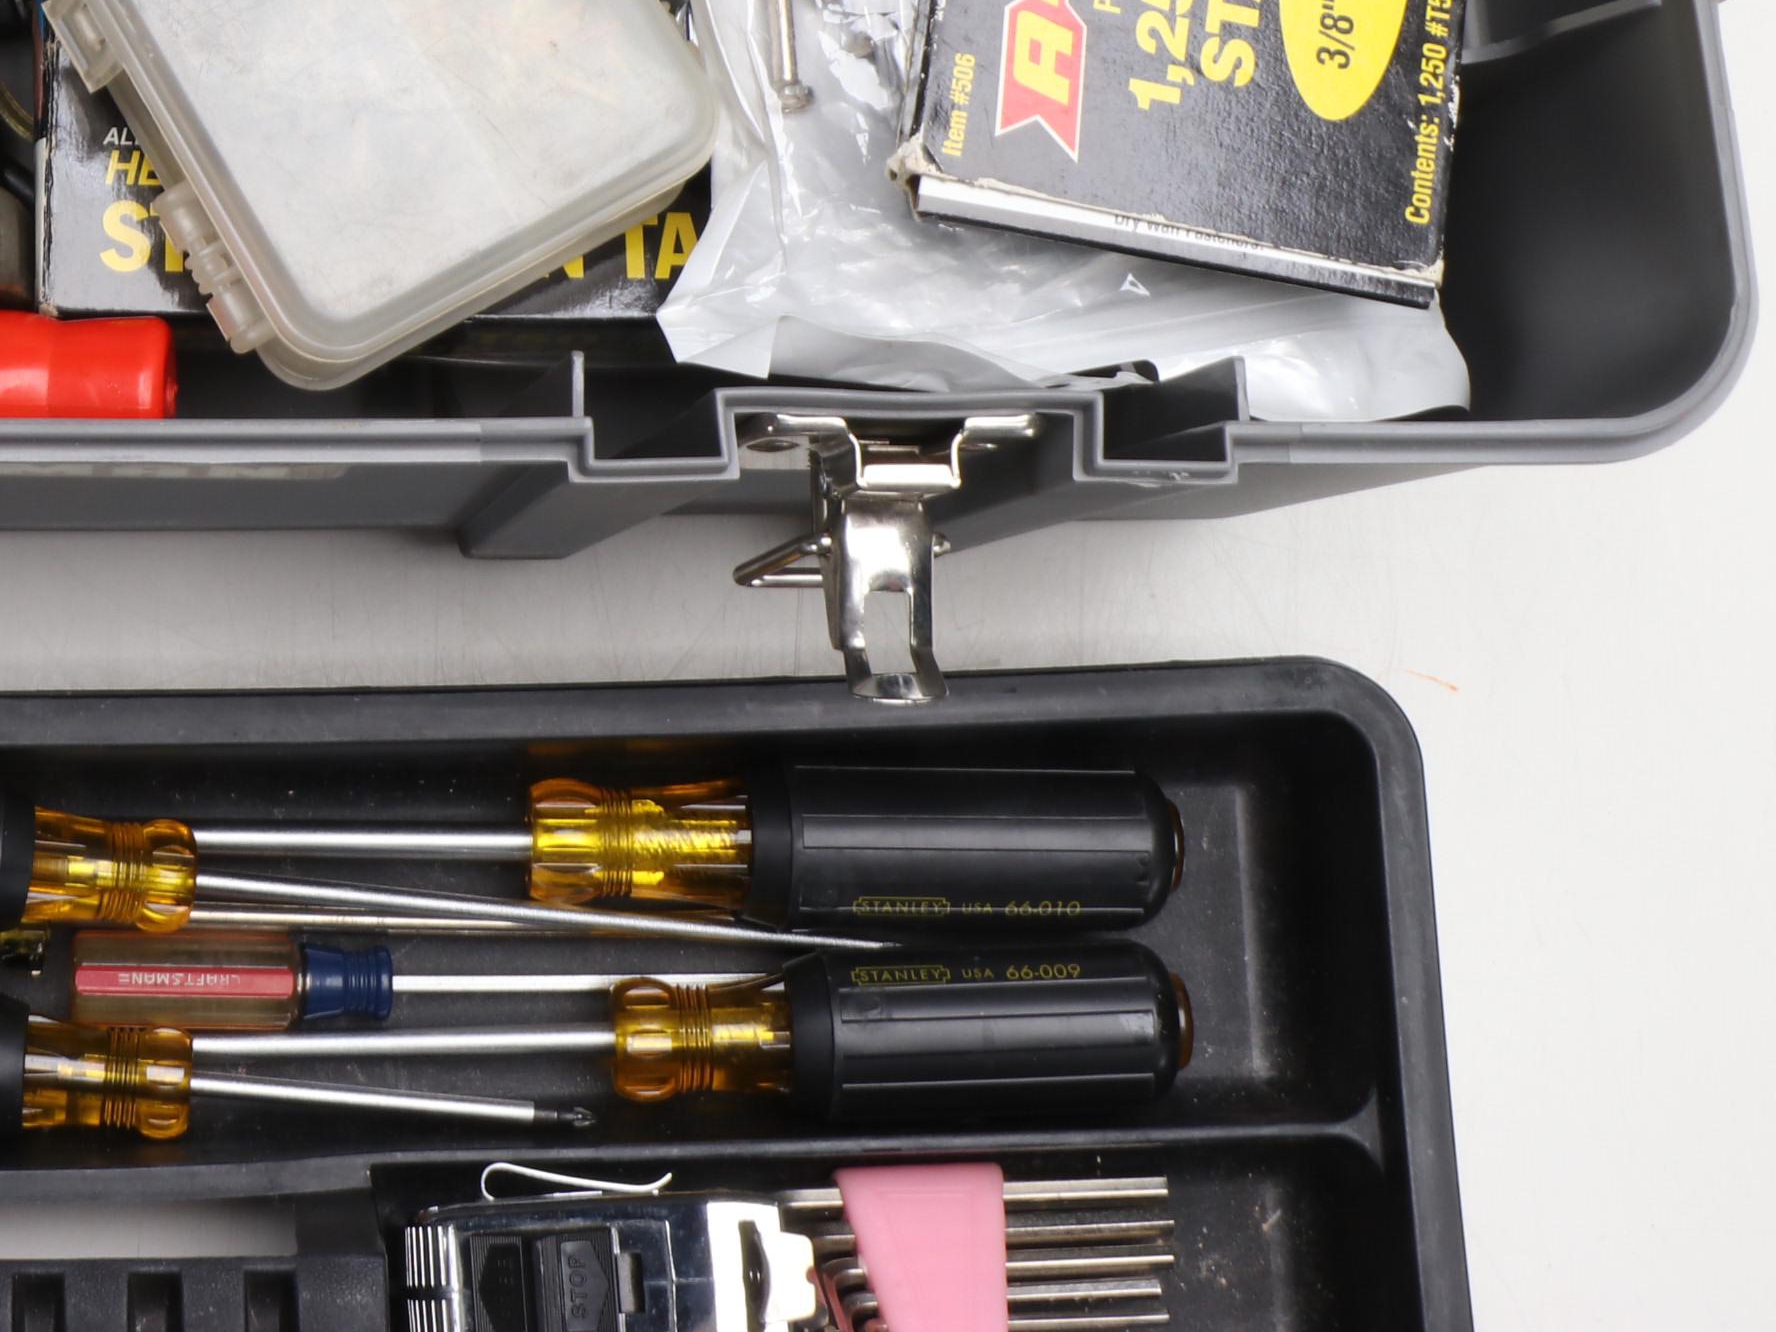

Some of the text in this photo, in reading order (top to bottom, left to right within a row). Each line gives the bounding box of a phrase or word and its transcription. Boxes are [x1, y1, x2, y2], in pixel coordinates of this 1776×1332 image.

[1417, 42, 1447, 108] 1,250
[942, 52, 976, 156] Item #506
[103, 126, 138, 146] AL
[1405, 114, 1440, 225] Contents:
[859, 898, 946, 914] STANLEY
[961, 902, 994, 915] USA
[130, 971, 242, 987] CRAFTSMAN
[858, 963, 1082, 983] STANLEY USA 66-009
[567, 1255, 588, 1320] STOP
